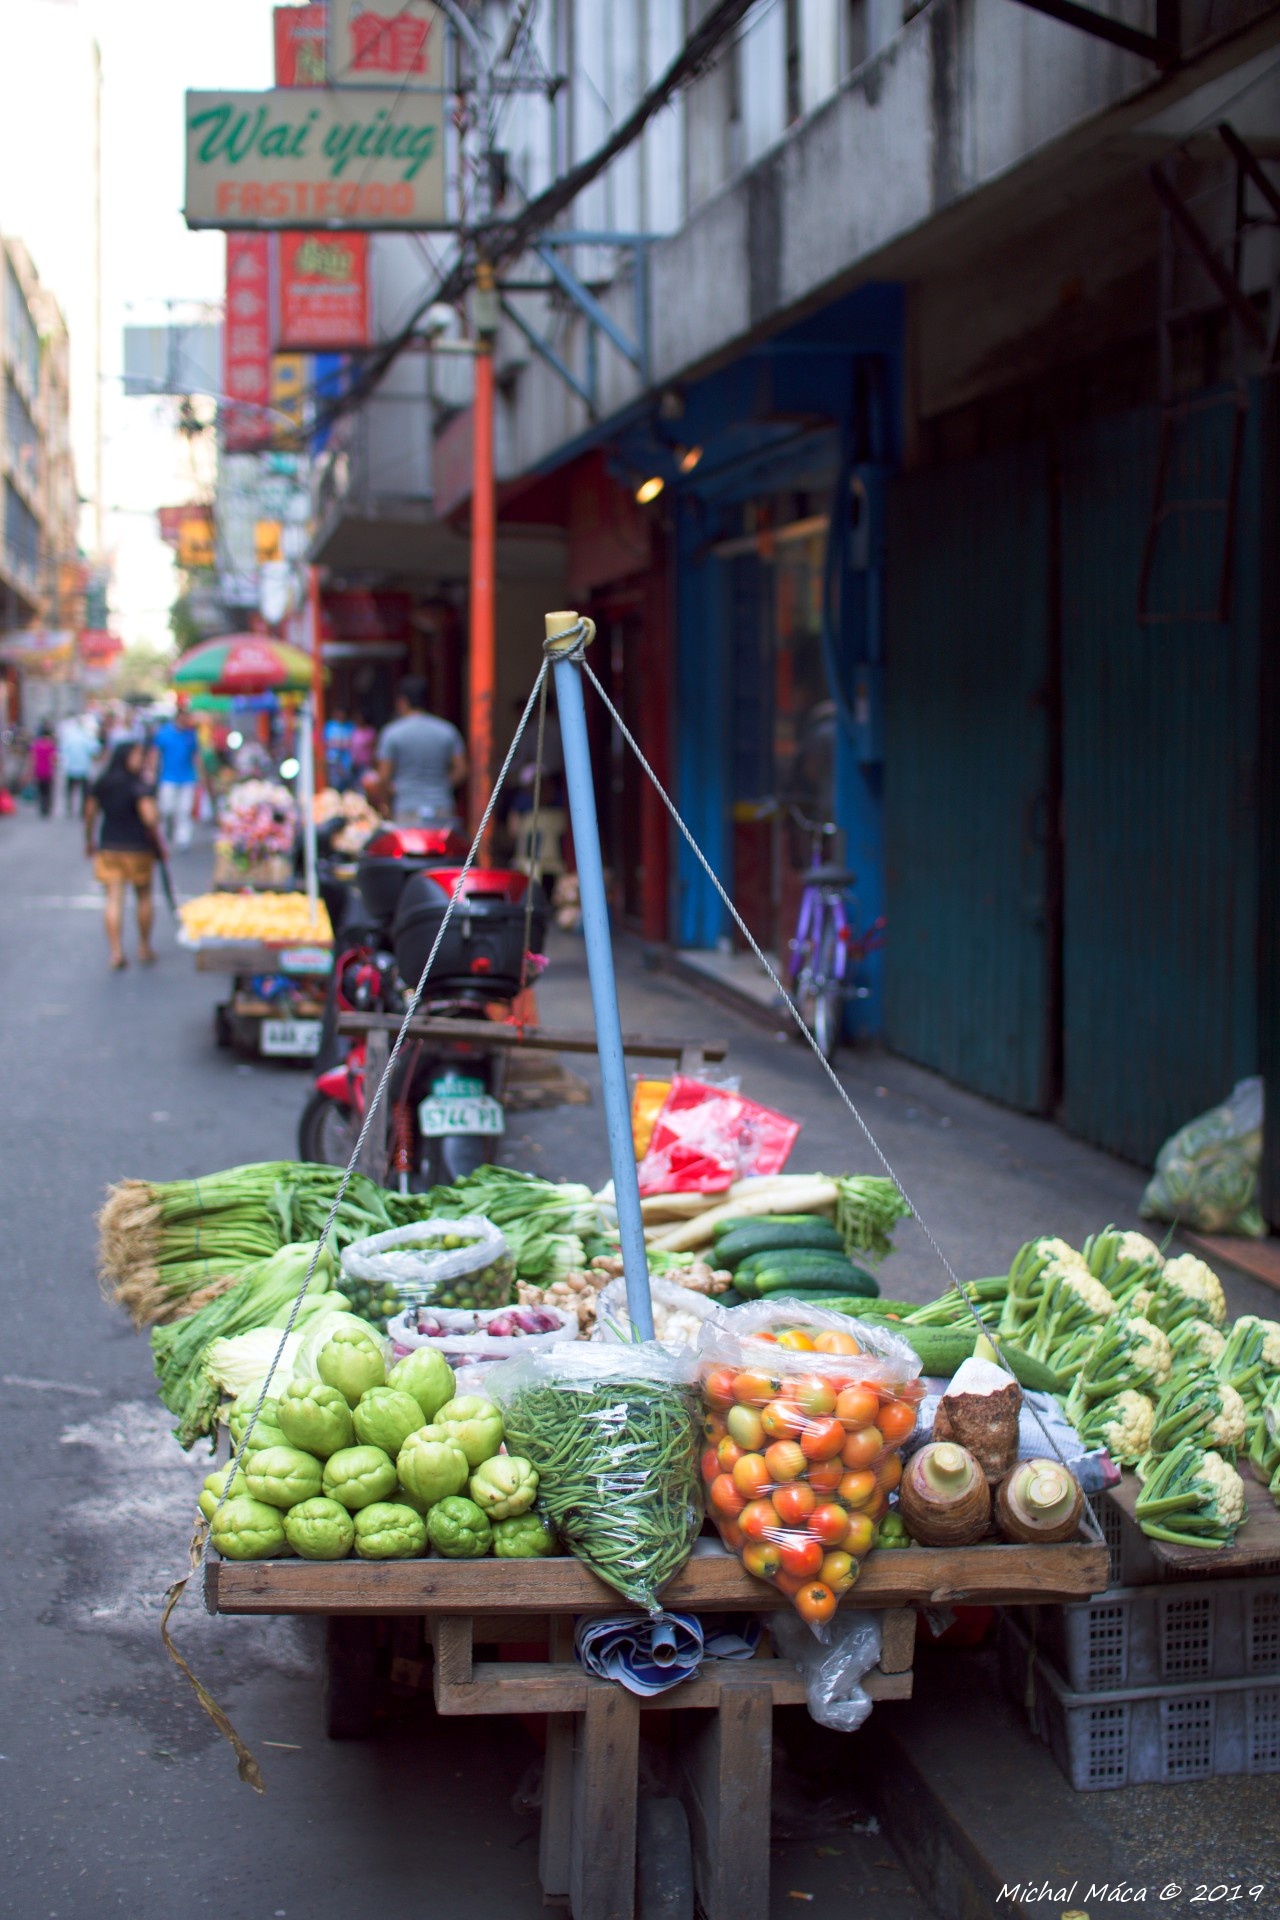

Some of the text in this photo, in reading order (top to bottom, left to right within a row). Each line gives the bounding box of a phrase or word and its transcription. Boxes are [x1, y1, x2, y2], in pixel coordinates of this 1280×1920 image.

[190, 102, 438, 182] Wai ying
[216, 180, 416, 217] FASTFOOD
